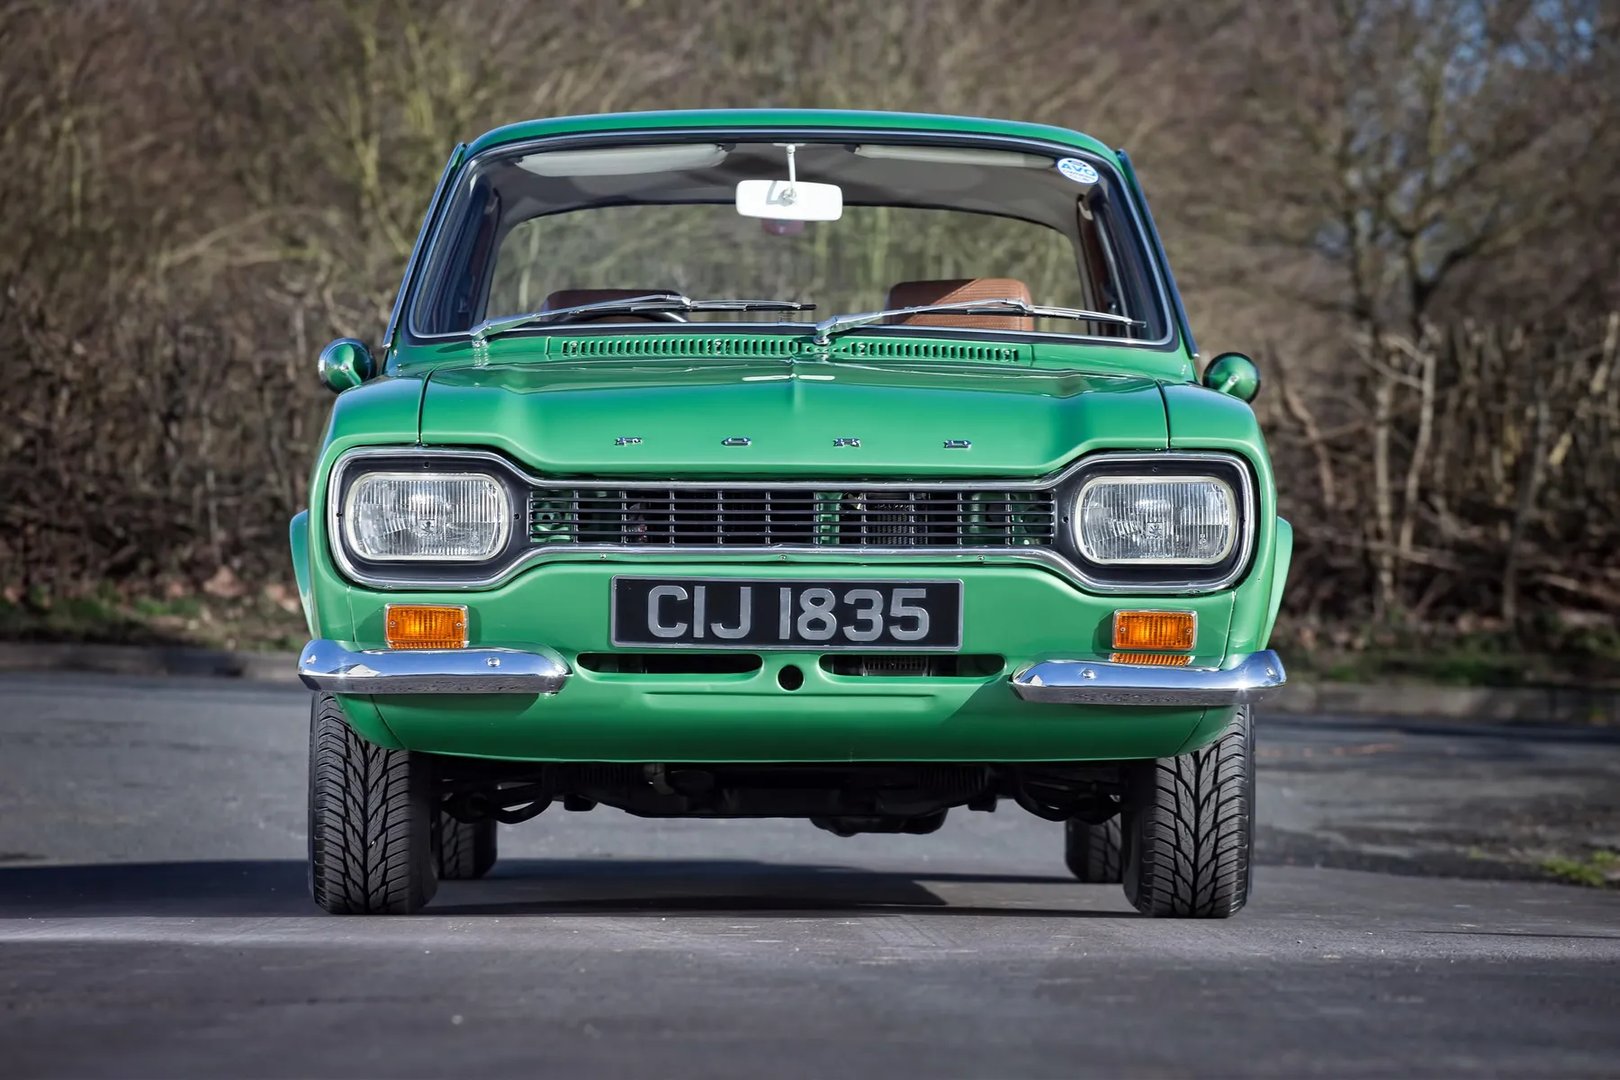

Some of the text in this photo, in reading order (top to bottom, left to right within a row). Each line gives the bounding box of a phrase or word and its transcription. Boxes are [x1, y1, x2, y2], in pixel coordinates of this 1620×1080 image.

[614, 436, 973, 450] FORD
[648, 585, 930, 642] CIJ 1835
